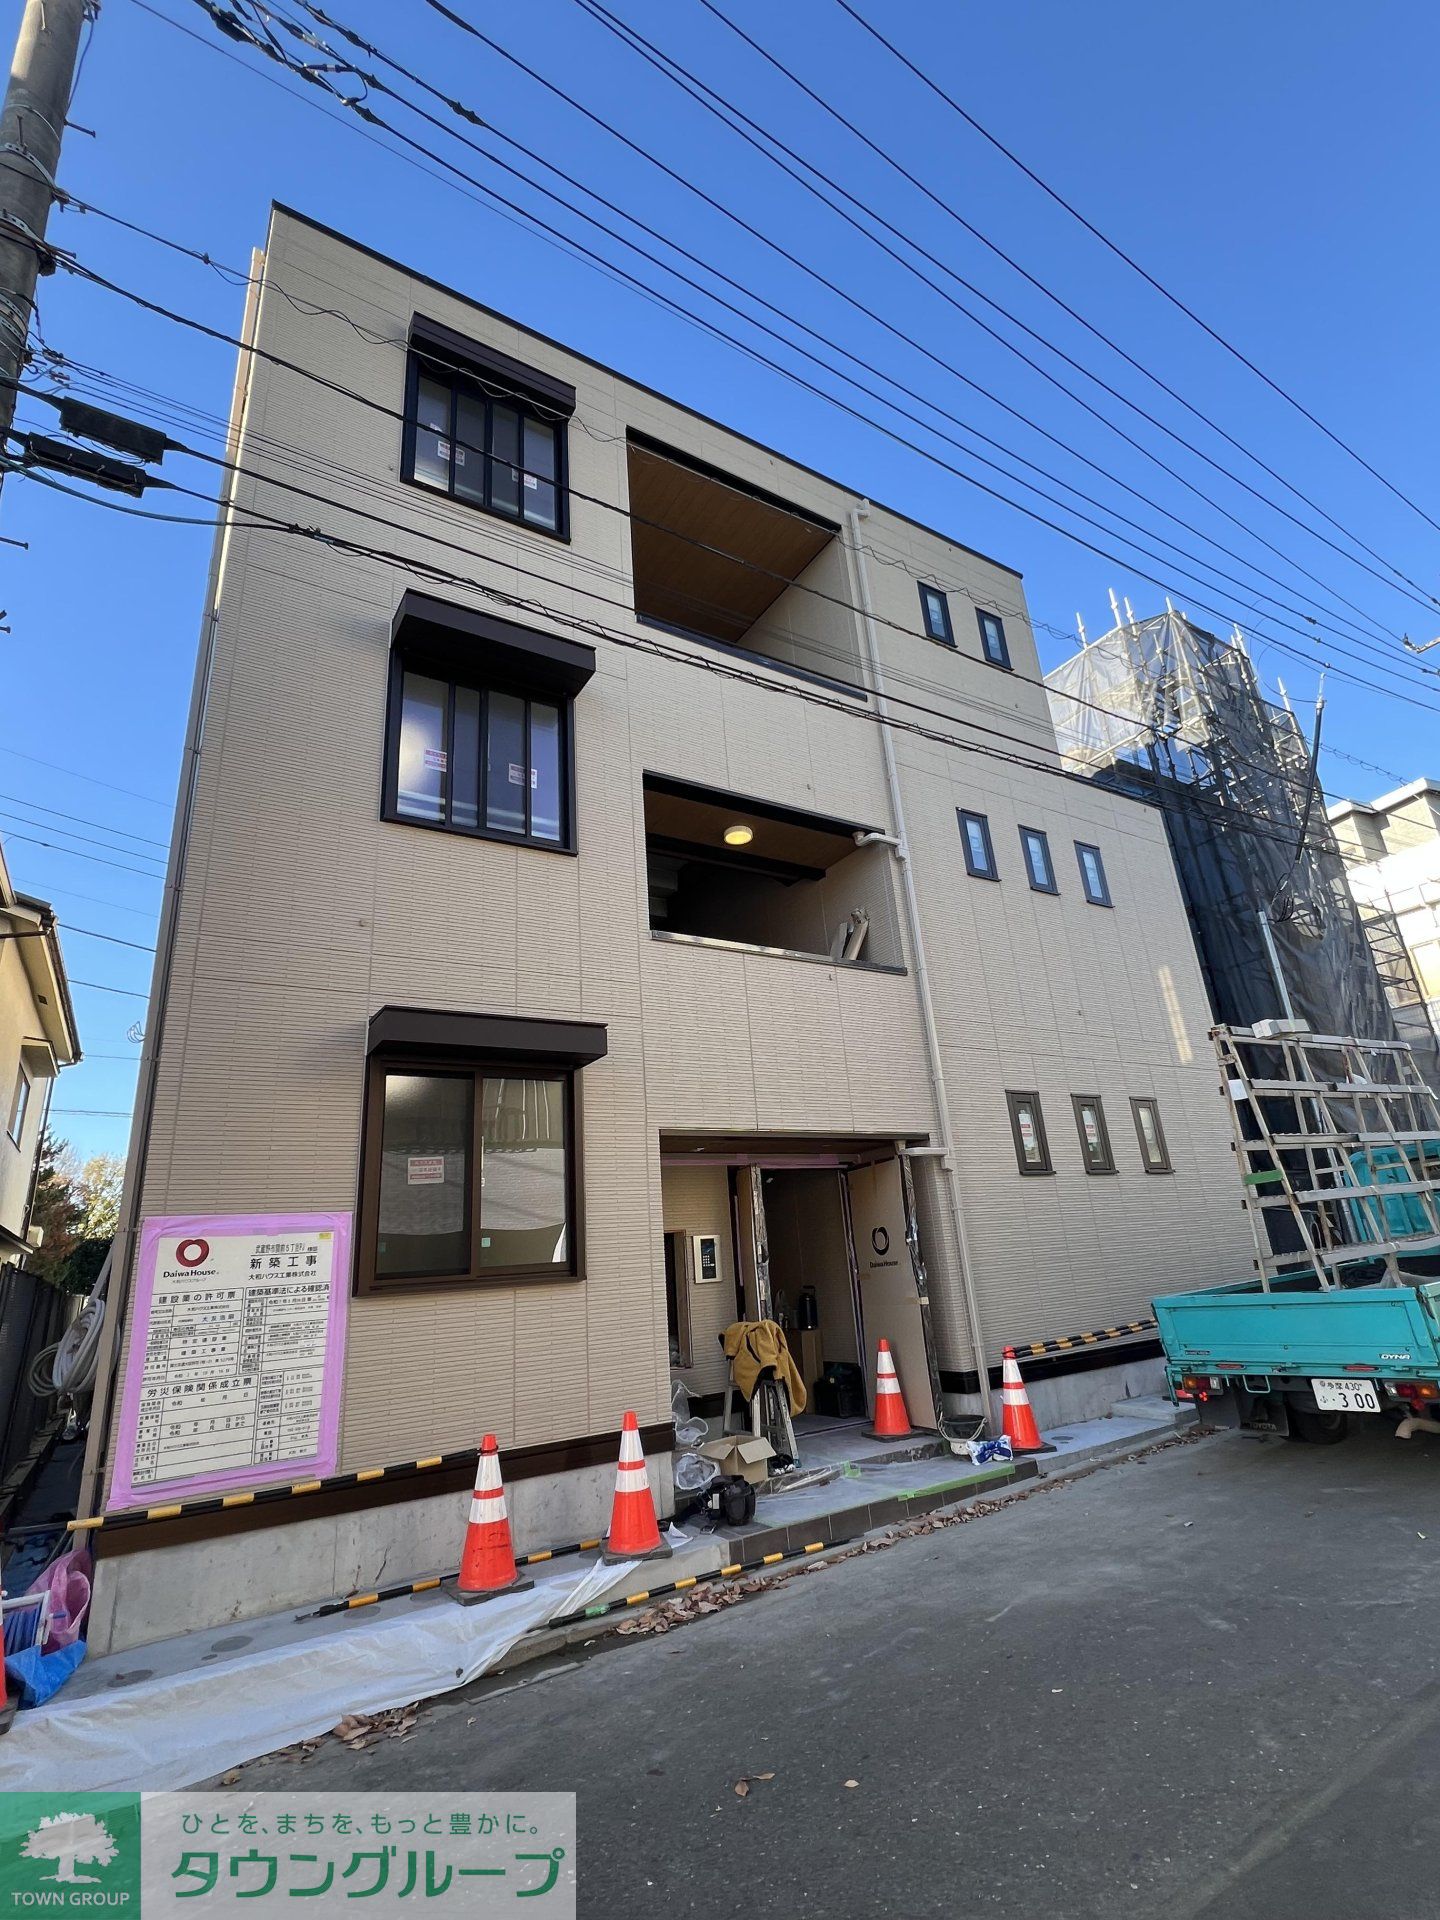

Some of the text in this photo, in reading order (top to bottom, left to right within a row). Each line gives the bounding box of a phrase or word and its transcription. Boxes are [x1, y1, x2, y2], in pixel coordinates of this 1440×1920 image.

[250, 1255, 317, 1269] 新築工事
[163, 1270, 189, 1278] Daiwa
[248, 1271, 316, 1280] 大和ハウス工業株式会社
[248, 1284, 330, 1297] 建築基準法による確認済
[159, 1291, 235, 1304] 建設業の許可票
[147, 1378, 252, 1398] 労災保険関係成立票
[1344, 1382, 1361, 1391] 430
